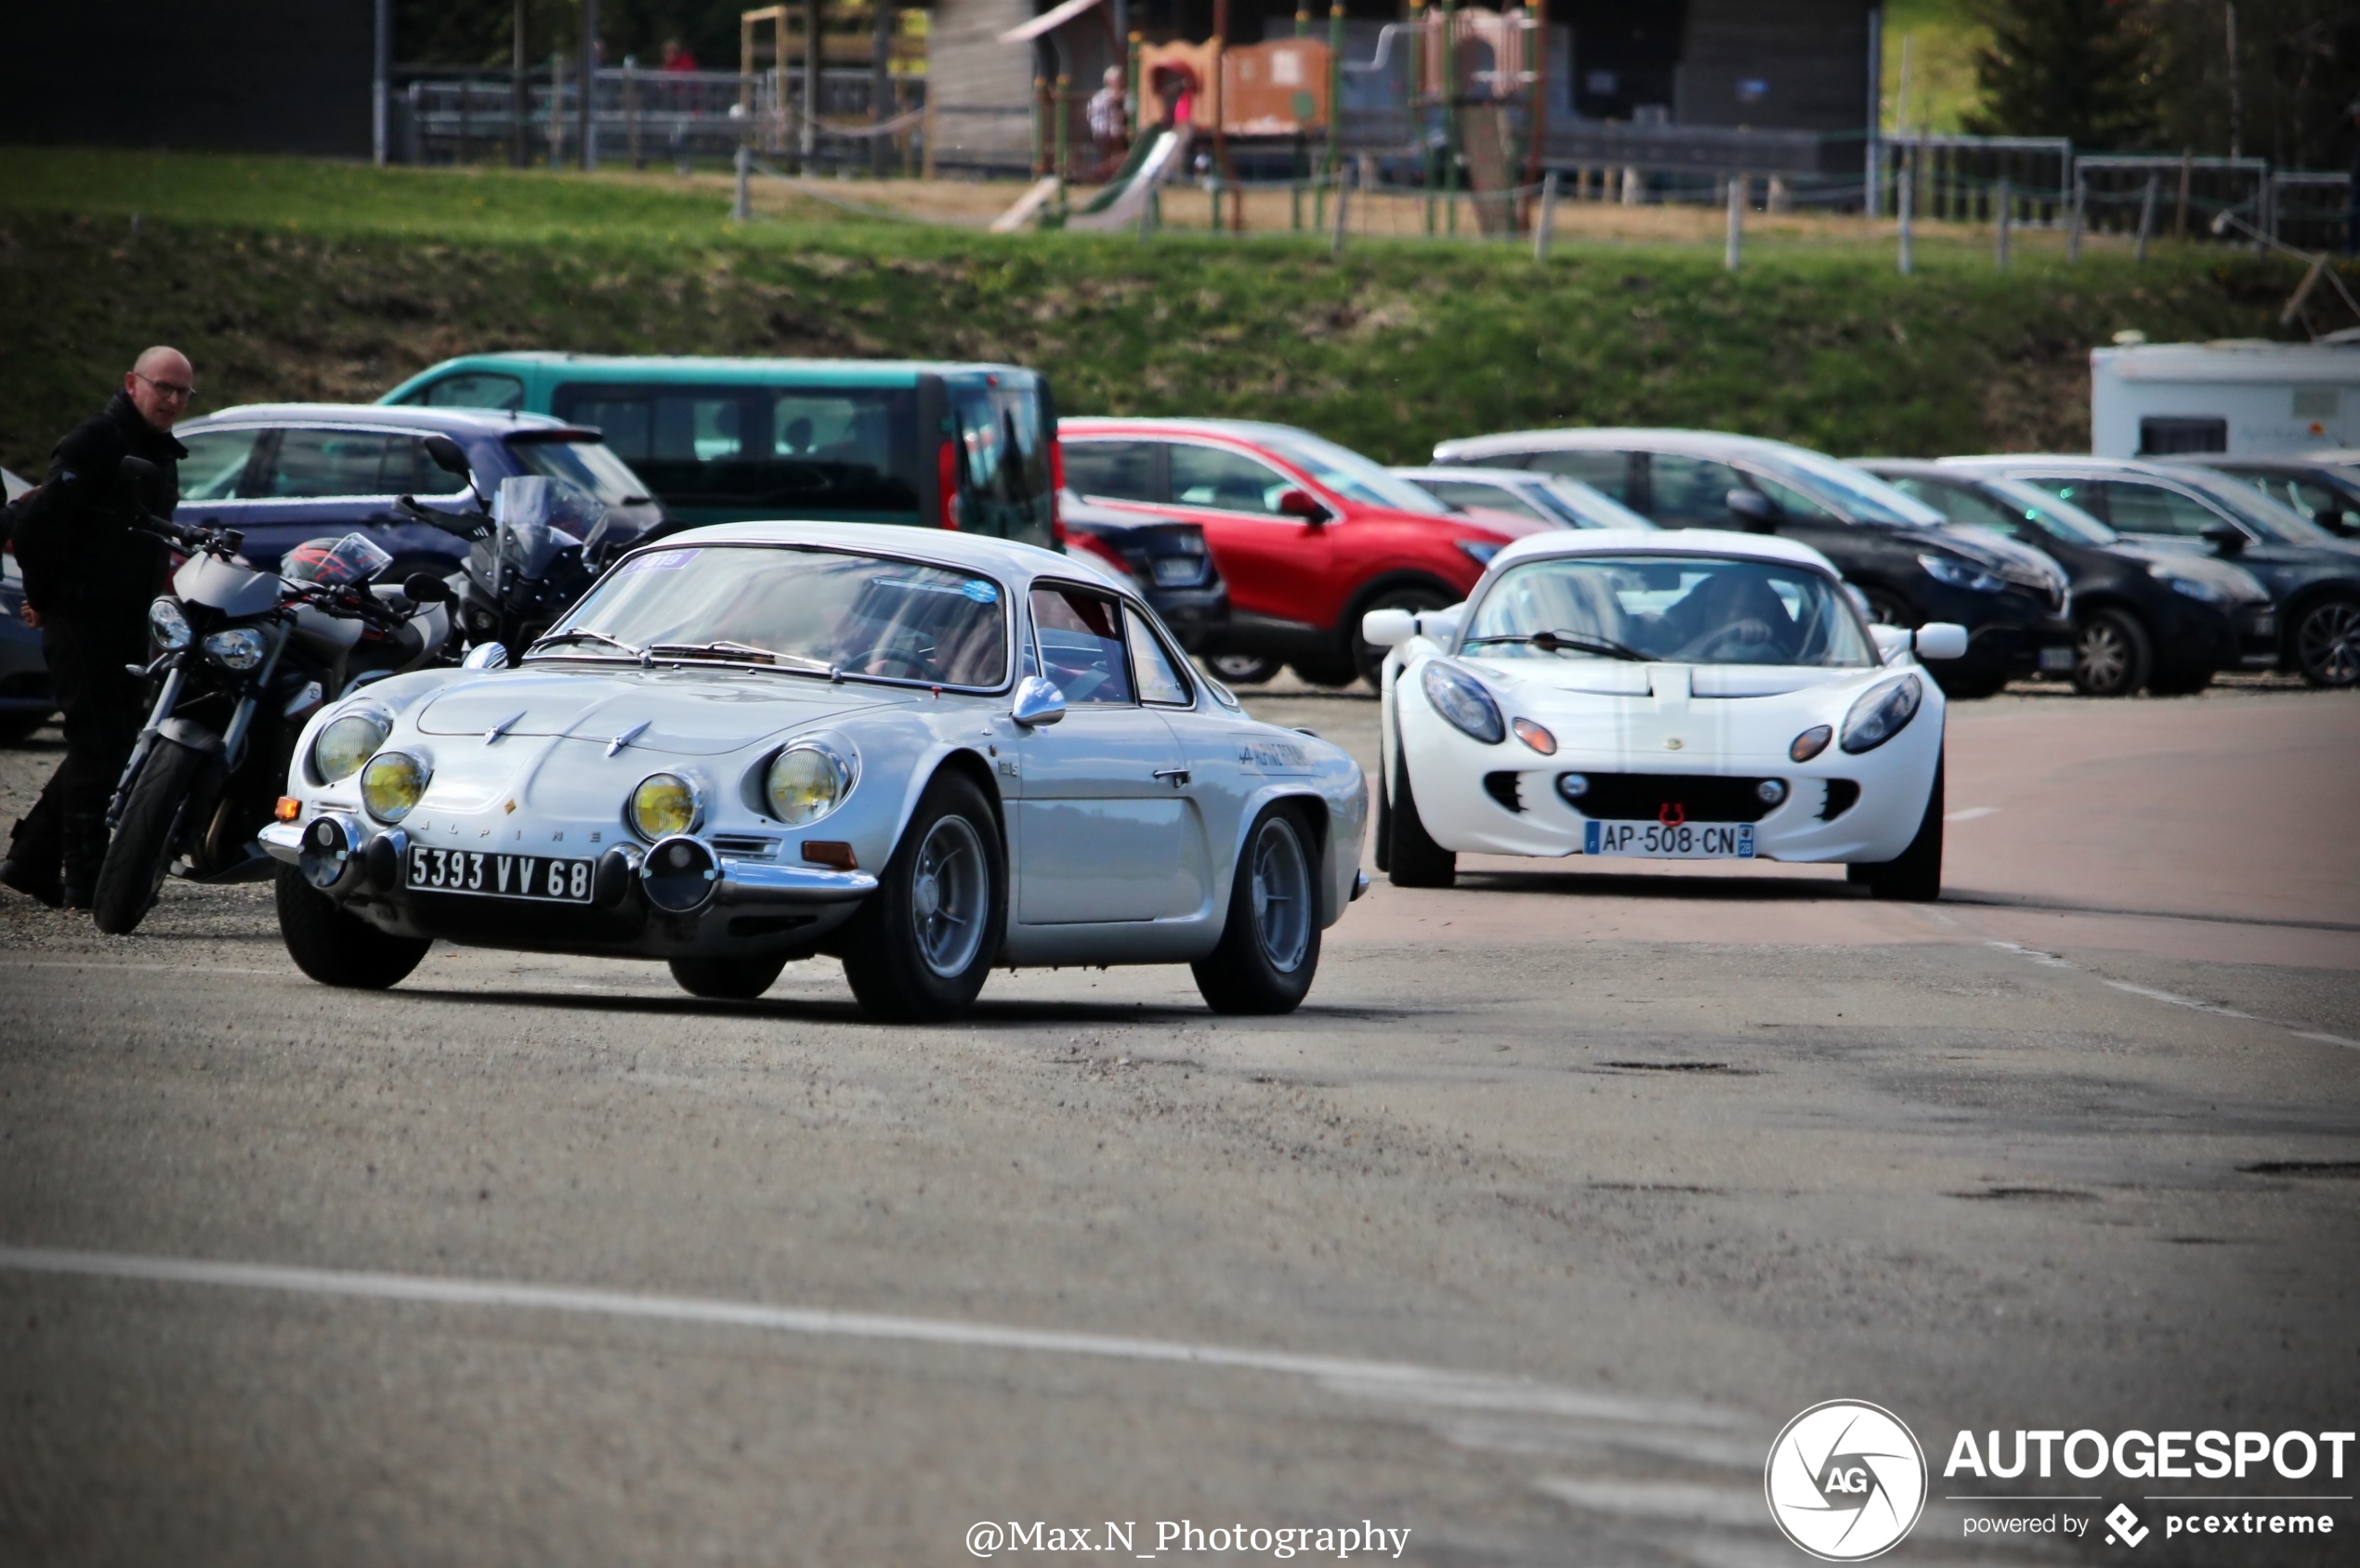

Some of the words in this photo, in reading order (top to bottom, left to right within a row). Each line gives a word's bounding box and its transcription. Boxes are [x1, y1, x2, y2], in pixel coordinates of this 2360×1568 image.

[420, 819, 601, 843] ALPINE
[1602, 824, 1736, 855] AP-508-CN
[1739, 842, 1752, 854] 2B
[413, 848, 484, 890] 5393
[497, 856, 535, 894] VV
[547, 860, 587, 898] 68
